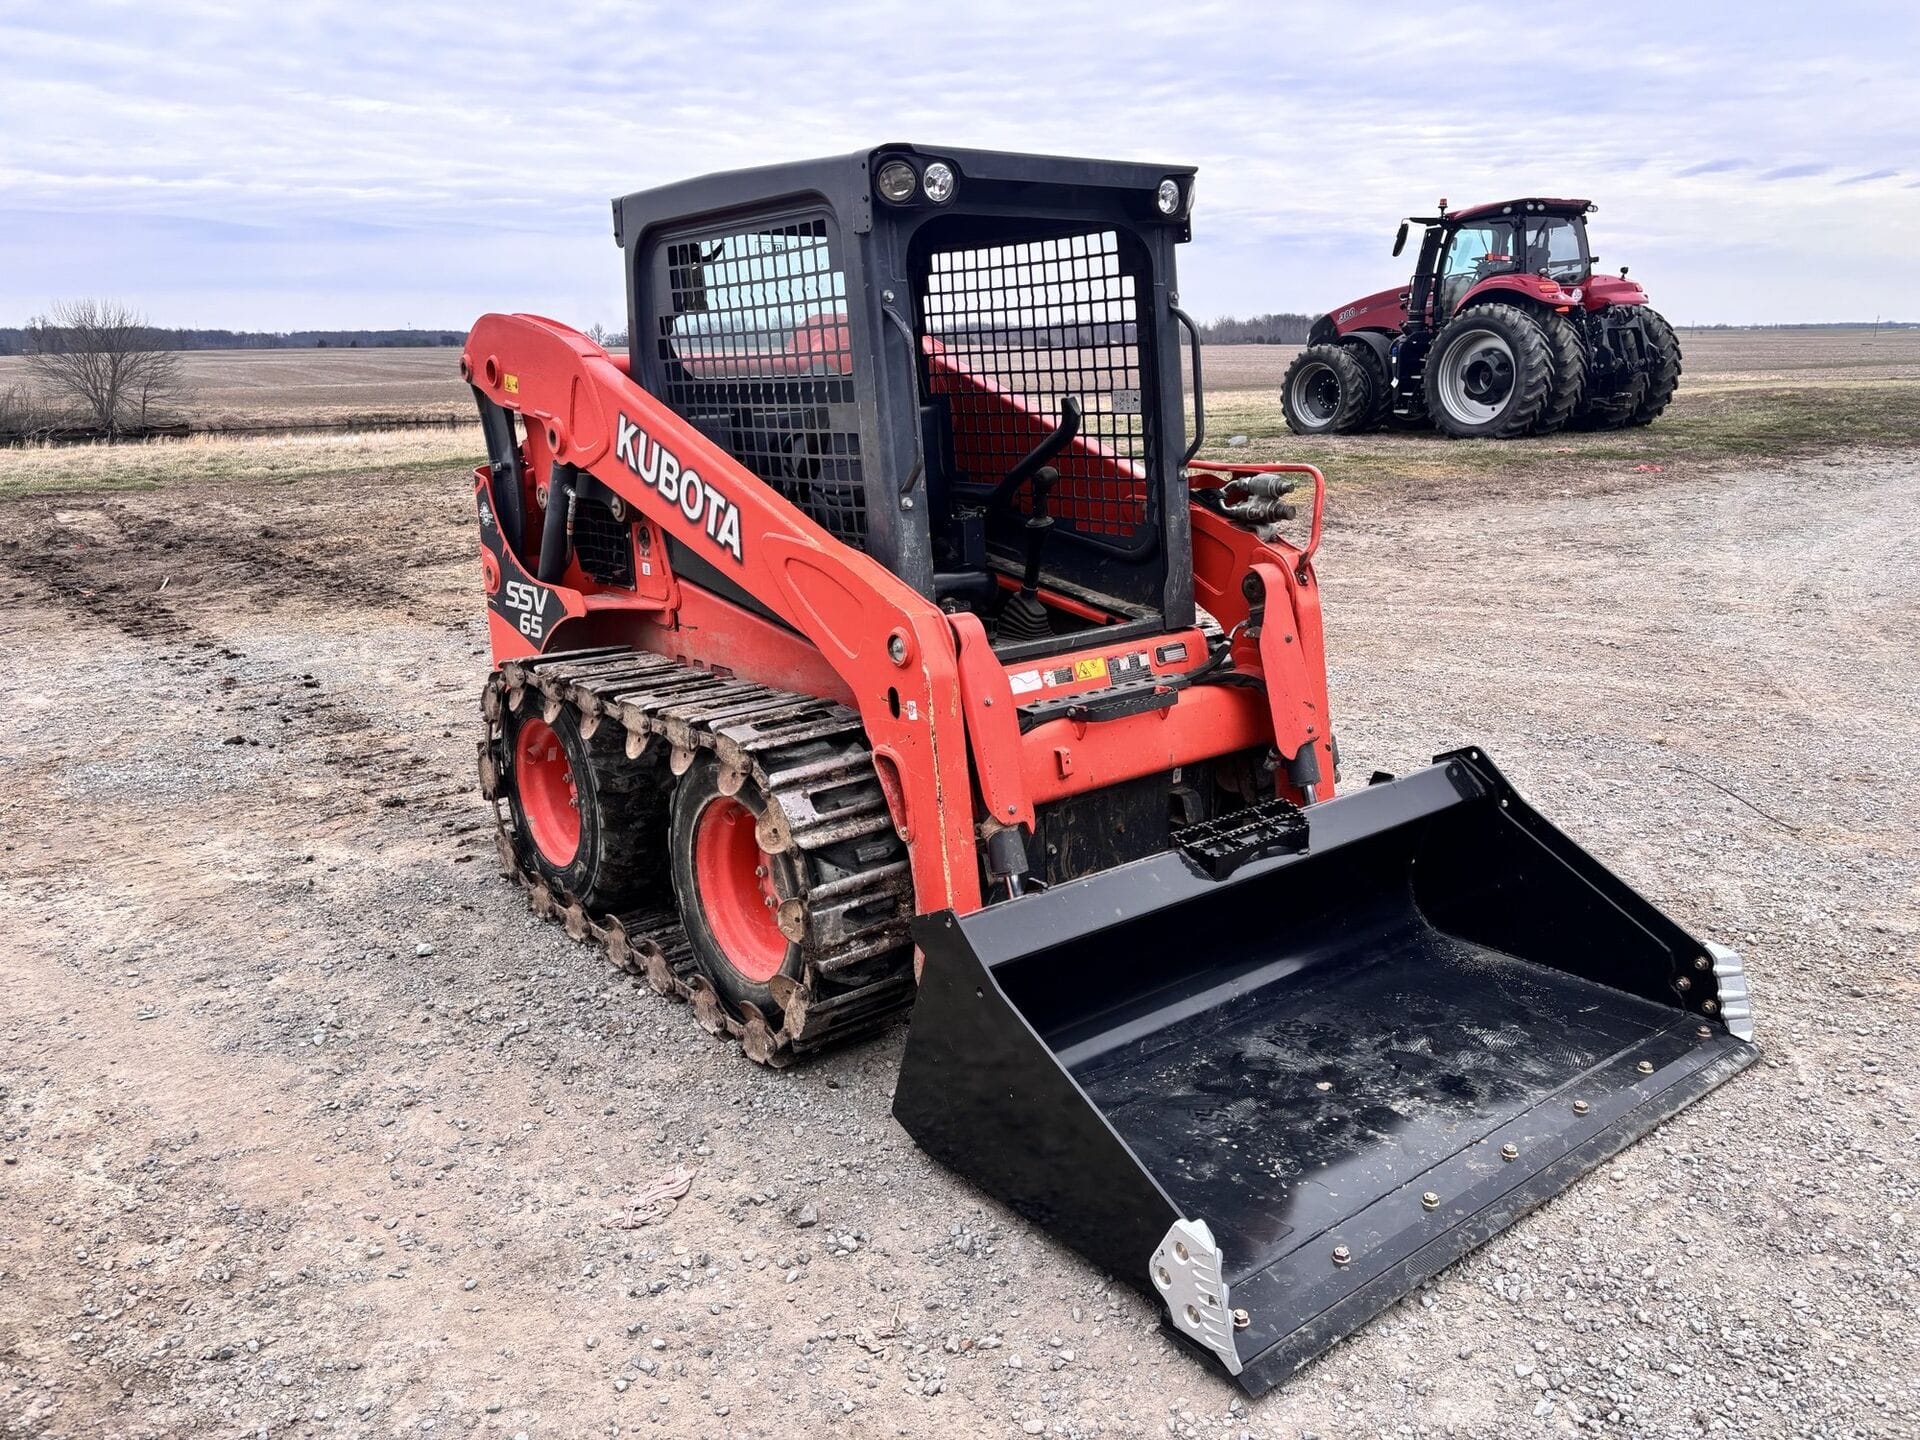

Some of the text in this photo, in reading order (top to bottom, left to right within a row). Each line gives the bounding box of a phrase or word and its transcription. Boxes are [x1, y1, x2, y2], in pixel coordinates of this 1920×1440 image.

[616, 413, 742, 561] KUBOTA
[505, 580, 549, 615] SSV
[519, 613, 543, 639] 65
